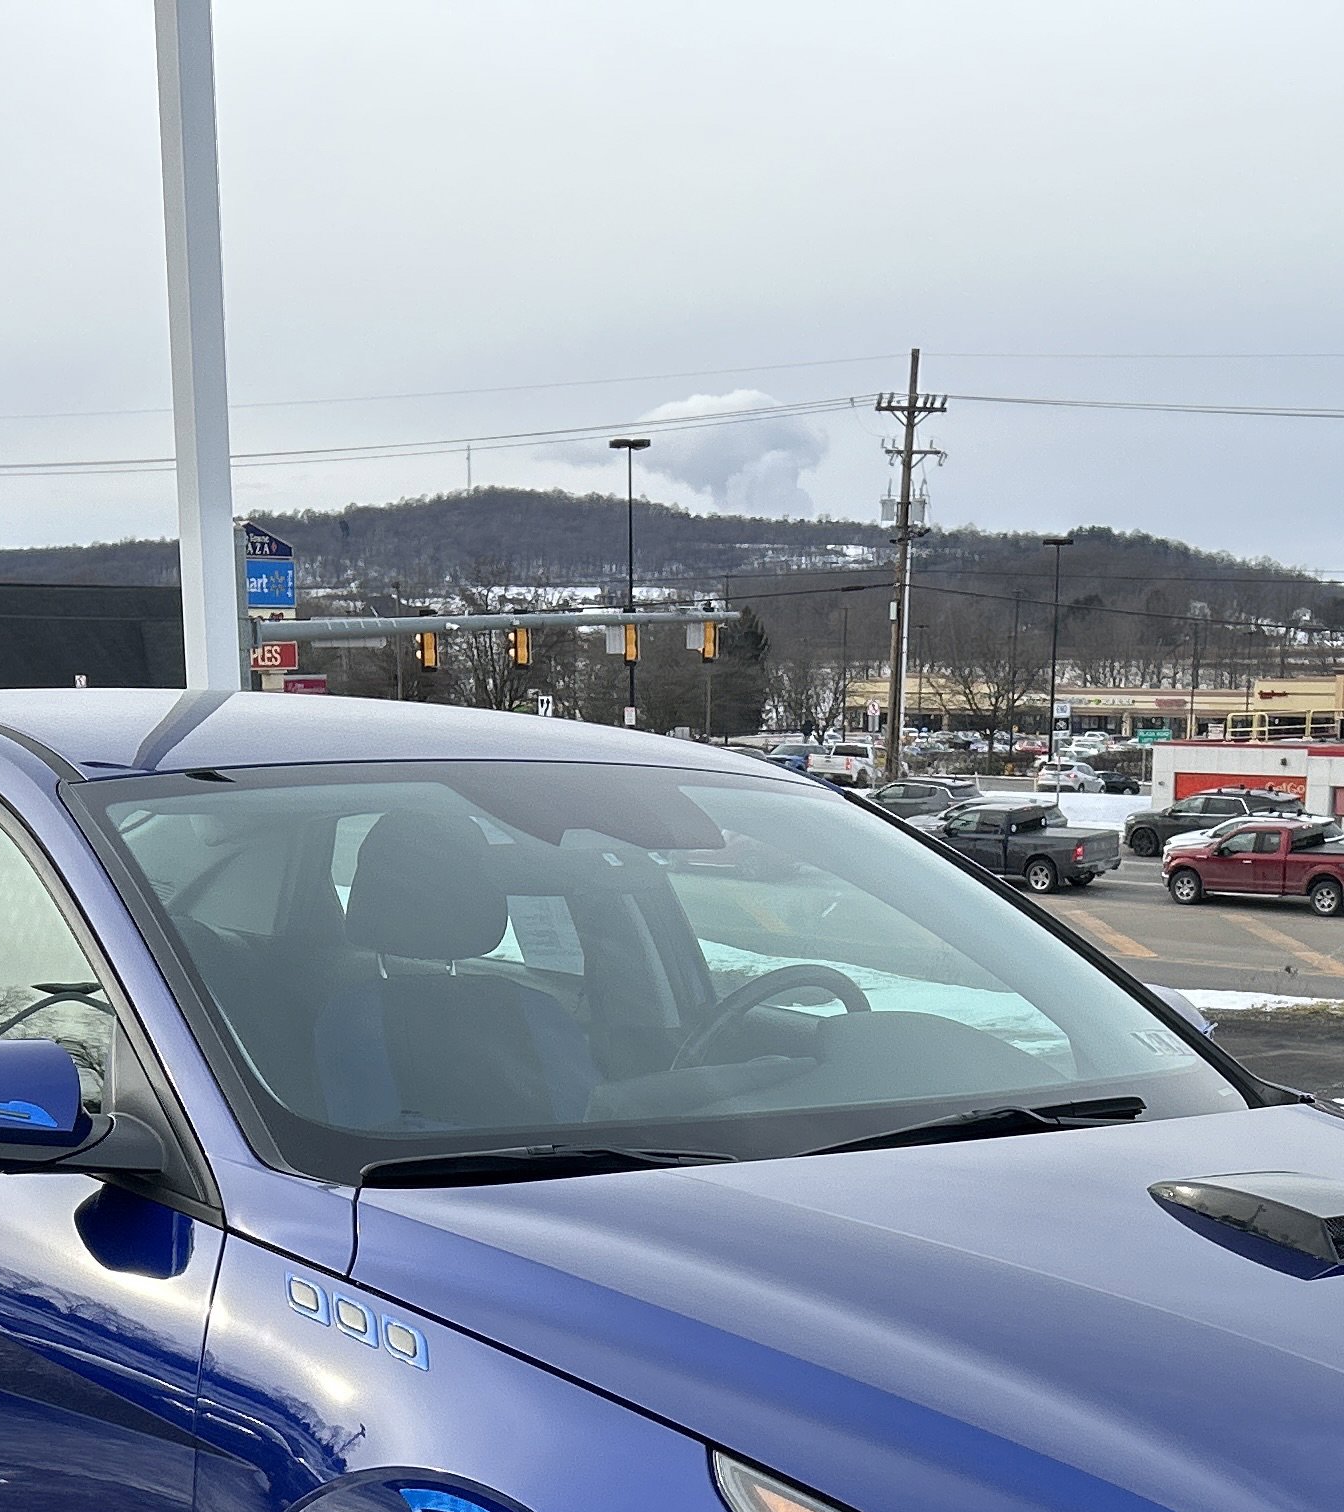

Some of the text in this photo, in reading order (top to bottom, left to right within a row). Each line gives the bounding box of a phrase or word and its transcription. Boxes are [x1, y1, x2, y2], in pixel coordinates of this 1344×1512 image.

[246, 543, 270, 555] AZA
[250, 645, 282, 666] PLES
[1265, 781, 1306, 794] GetGo
